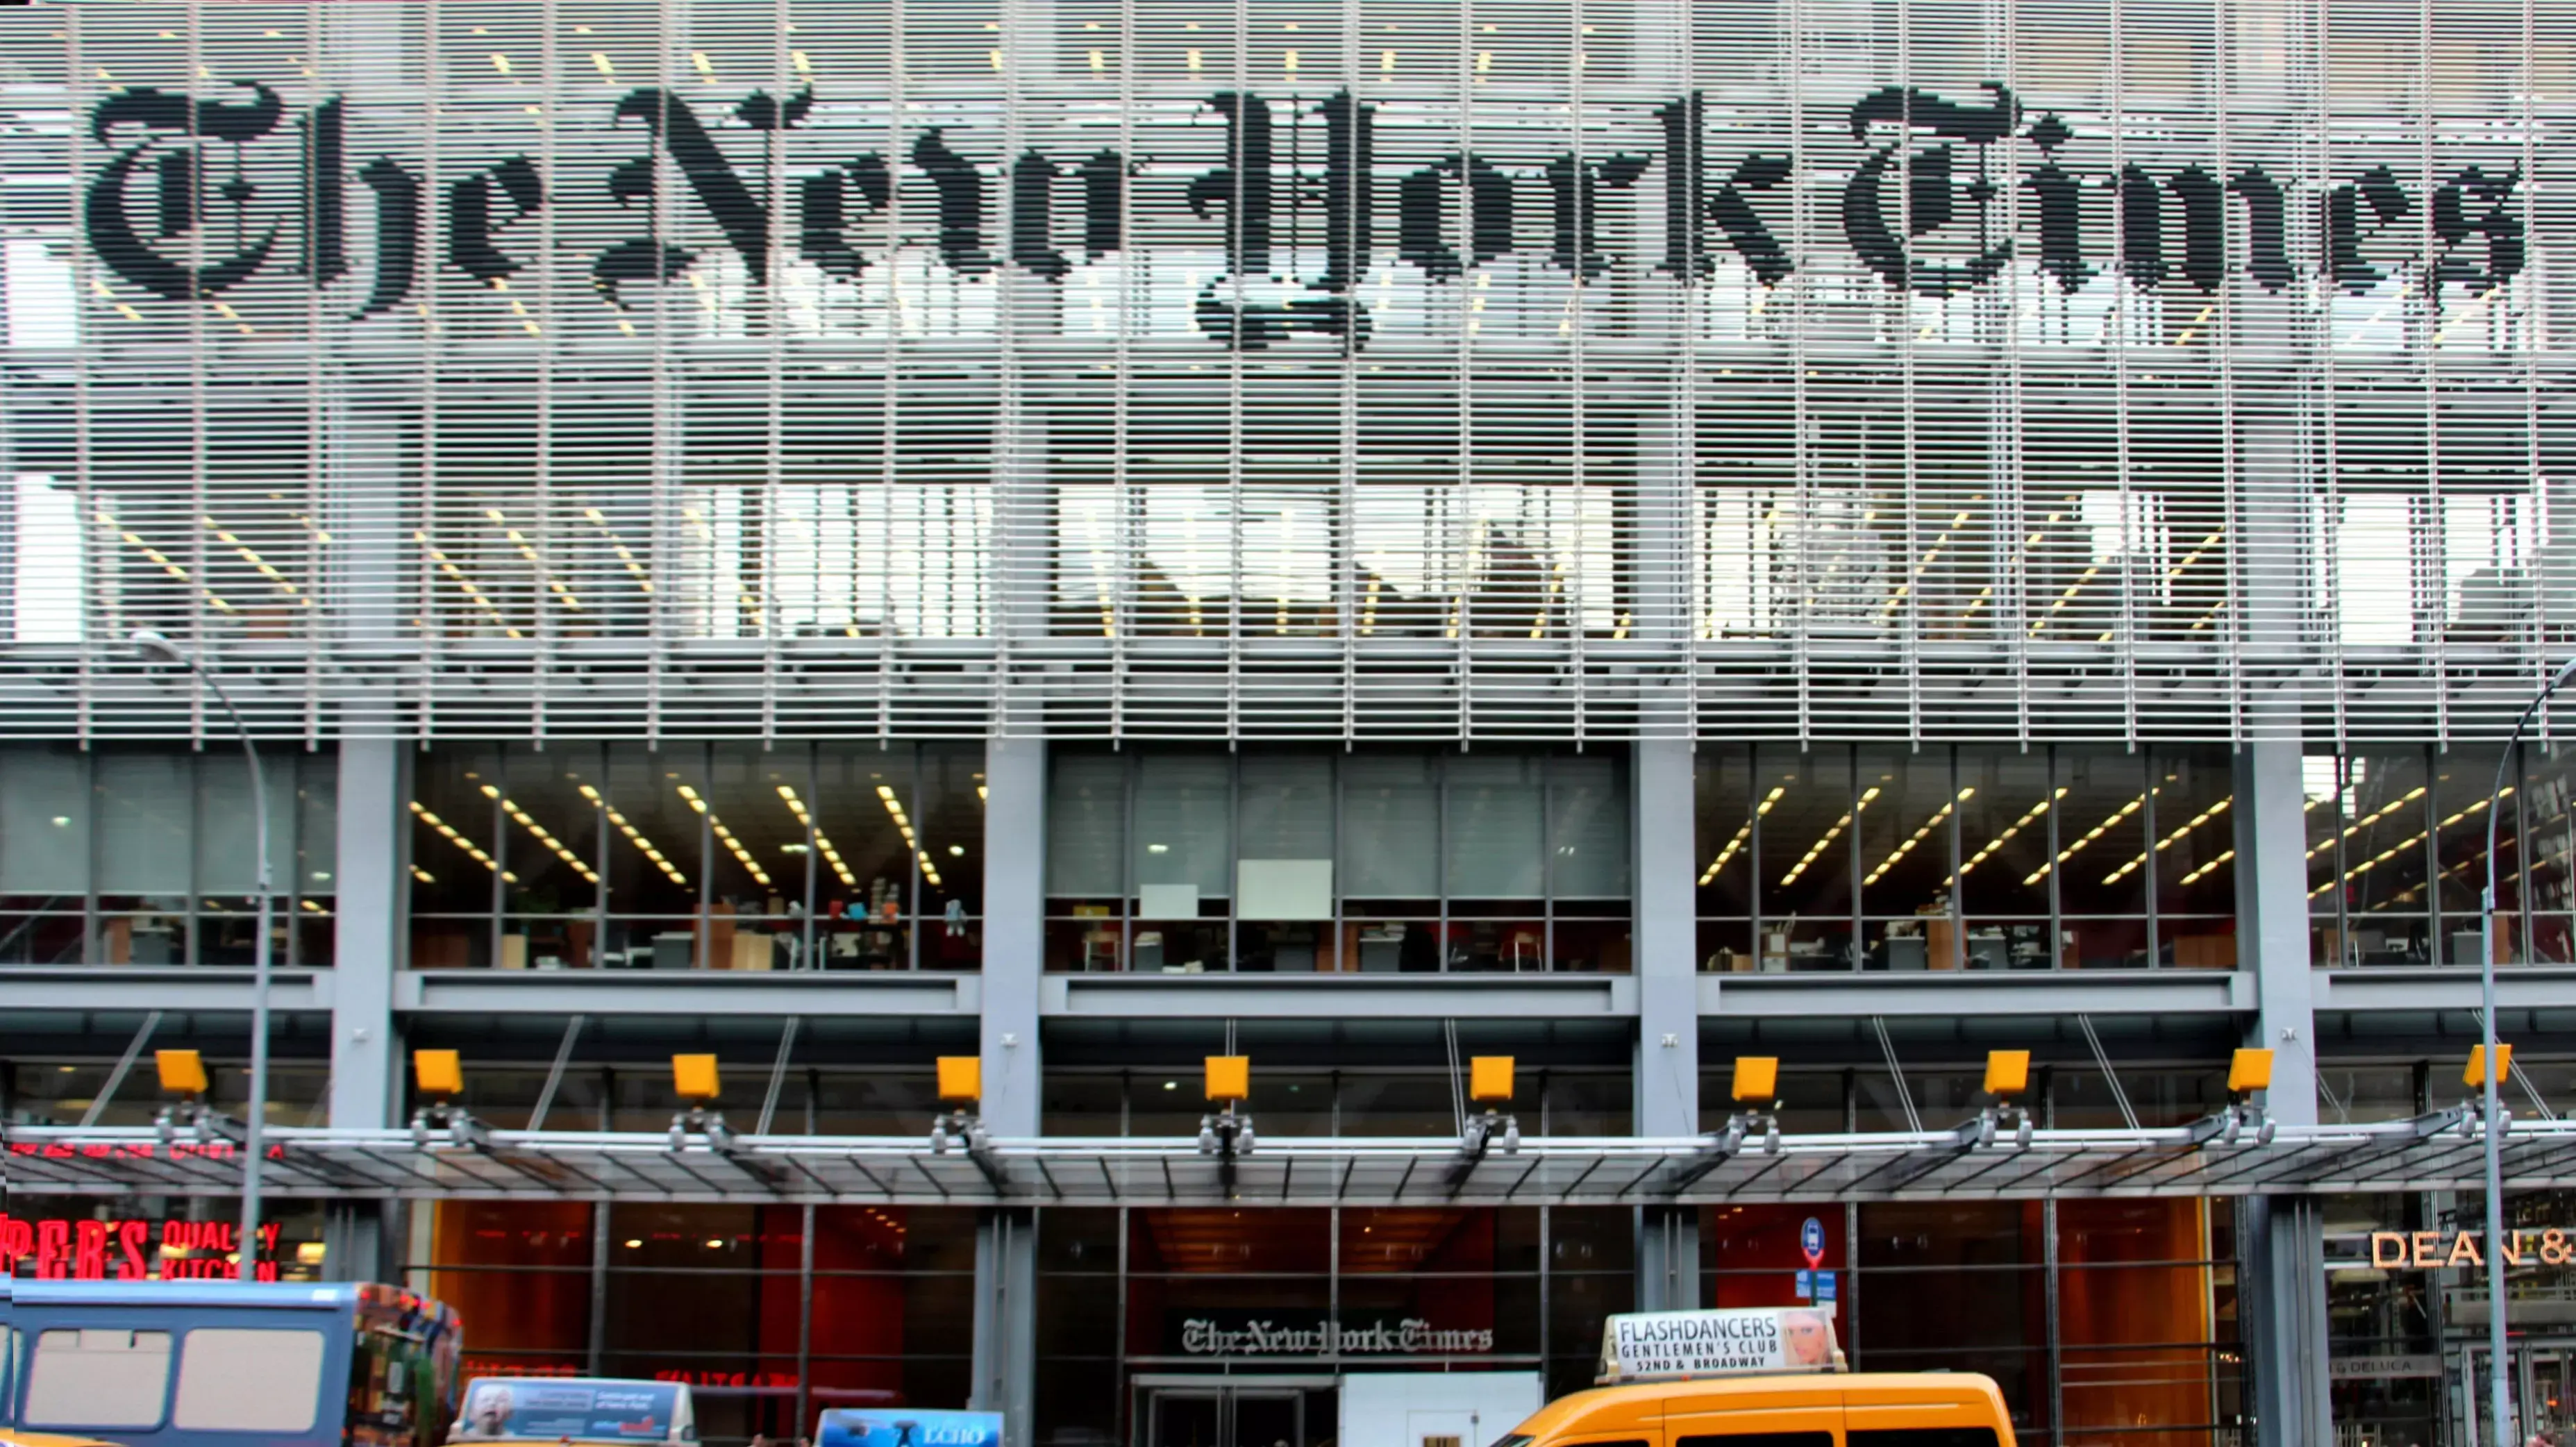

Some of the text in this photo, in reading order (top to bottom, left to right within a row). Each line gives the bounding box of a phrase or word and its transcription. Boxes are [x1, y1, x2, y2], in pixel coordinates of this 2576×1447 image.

[84, 80, 2525, 353] The New York Times
[162, 1220, 281, 1251] QUALY
[2540, 1228, 2574, 1266] &
[160, 1259, 278, 1282] KITCHN
[1182, 1319, 1493, 1357] The New York Times
[1620, 1316, 1777, 1343] FLASHDANCERS
[1621, 1339, 1778, 1359] GENTLEMEN'S CLUB
[1637, 1355, 1766, 1373] 52ND & BROADWAY
